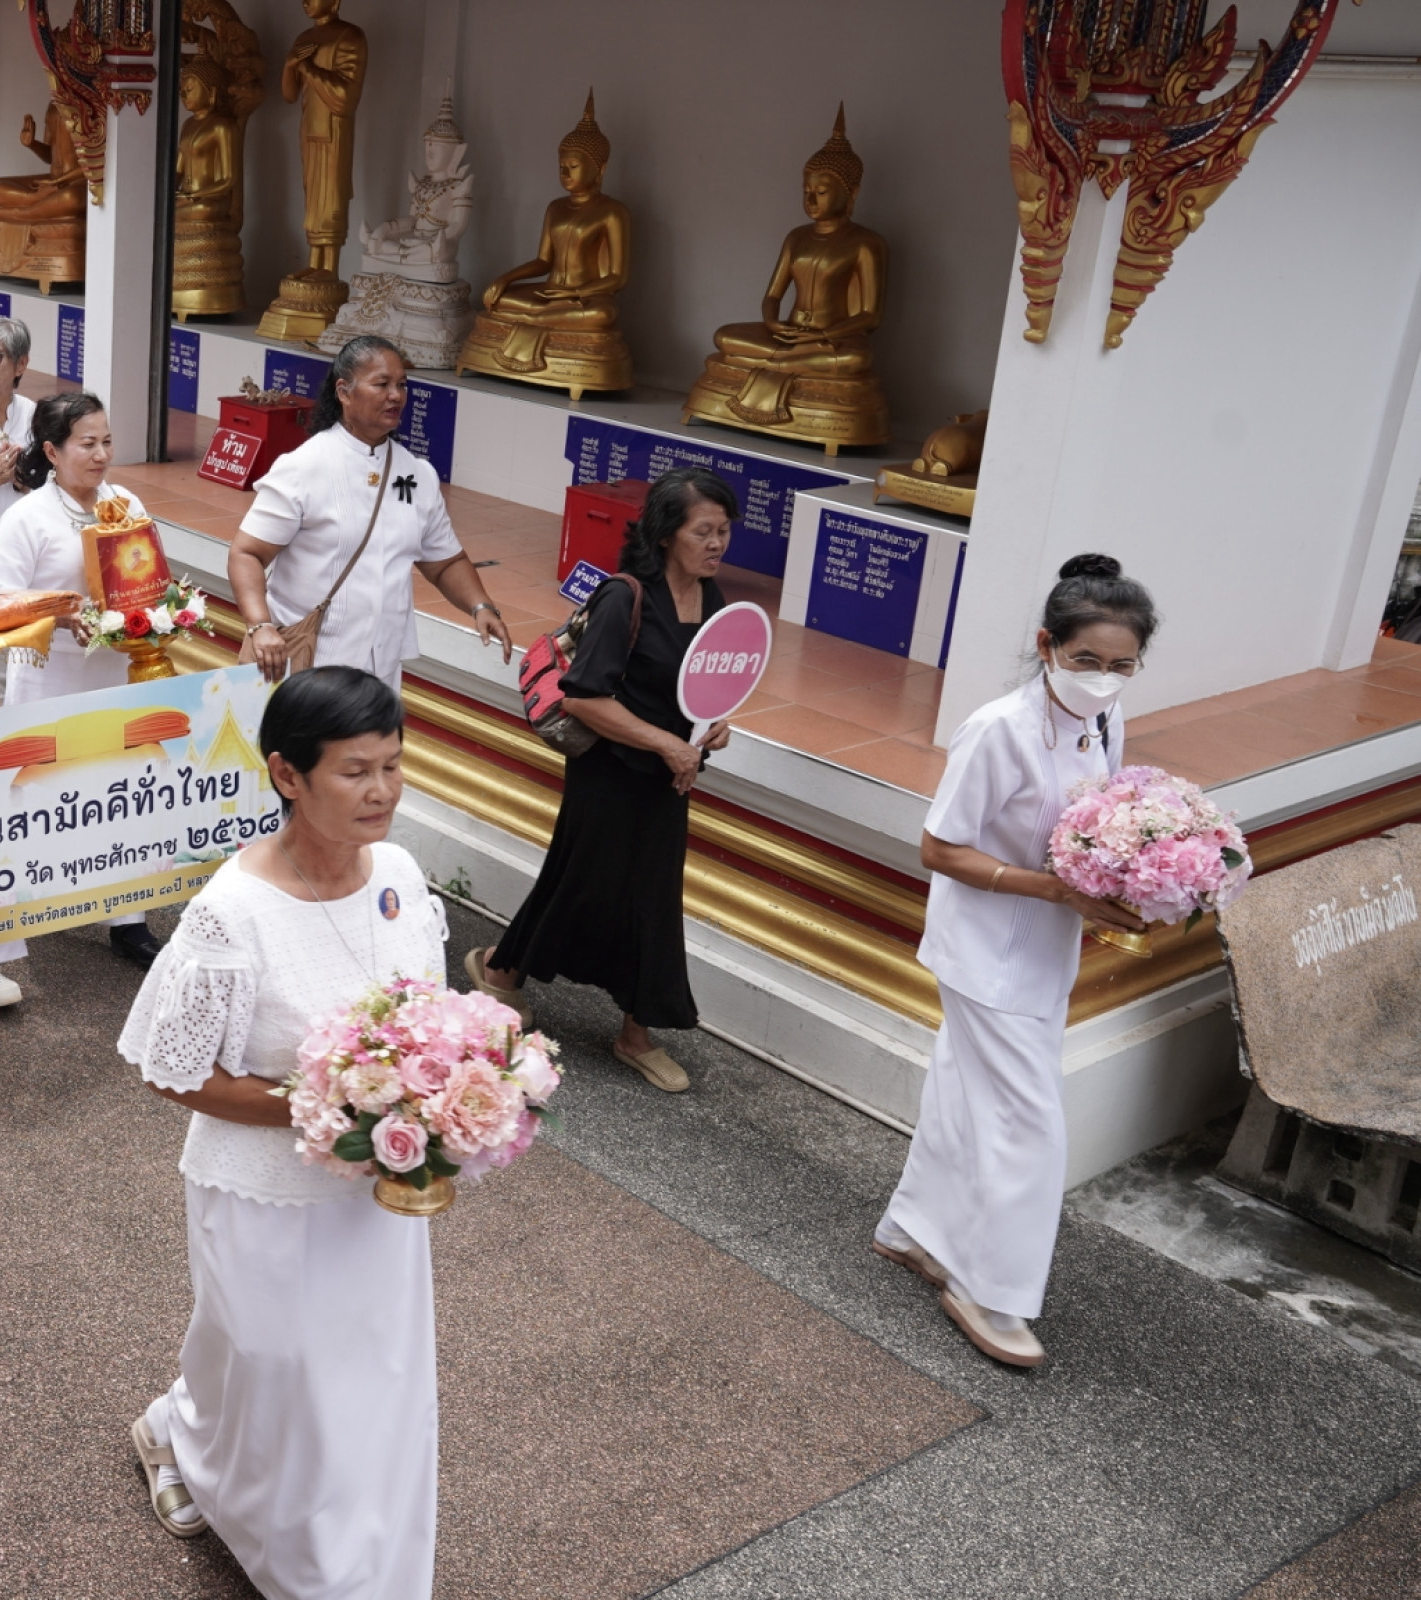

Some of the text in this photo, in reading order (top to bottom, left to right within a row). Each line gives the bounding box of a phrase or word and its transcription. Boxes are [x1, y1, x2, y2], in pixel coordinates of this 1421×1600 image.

[221, 433, 247, 458] ห้าม
[688, 649, 761, 674] สงขลา
[25, 860, 53, 885] วัด
[61, 838, 178, 885] พุทธศักราช
[187, 808, 280, 849] ๒๕๖๘
[20, 900, 98, 927] จังหวัดสงขลา
